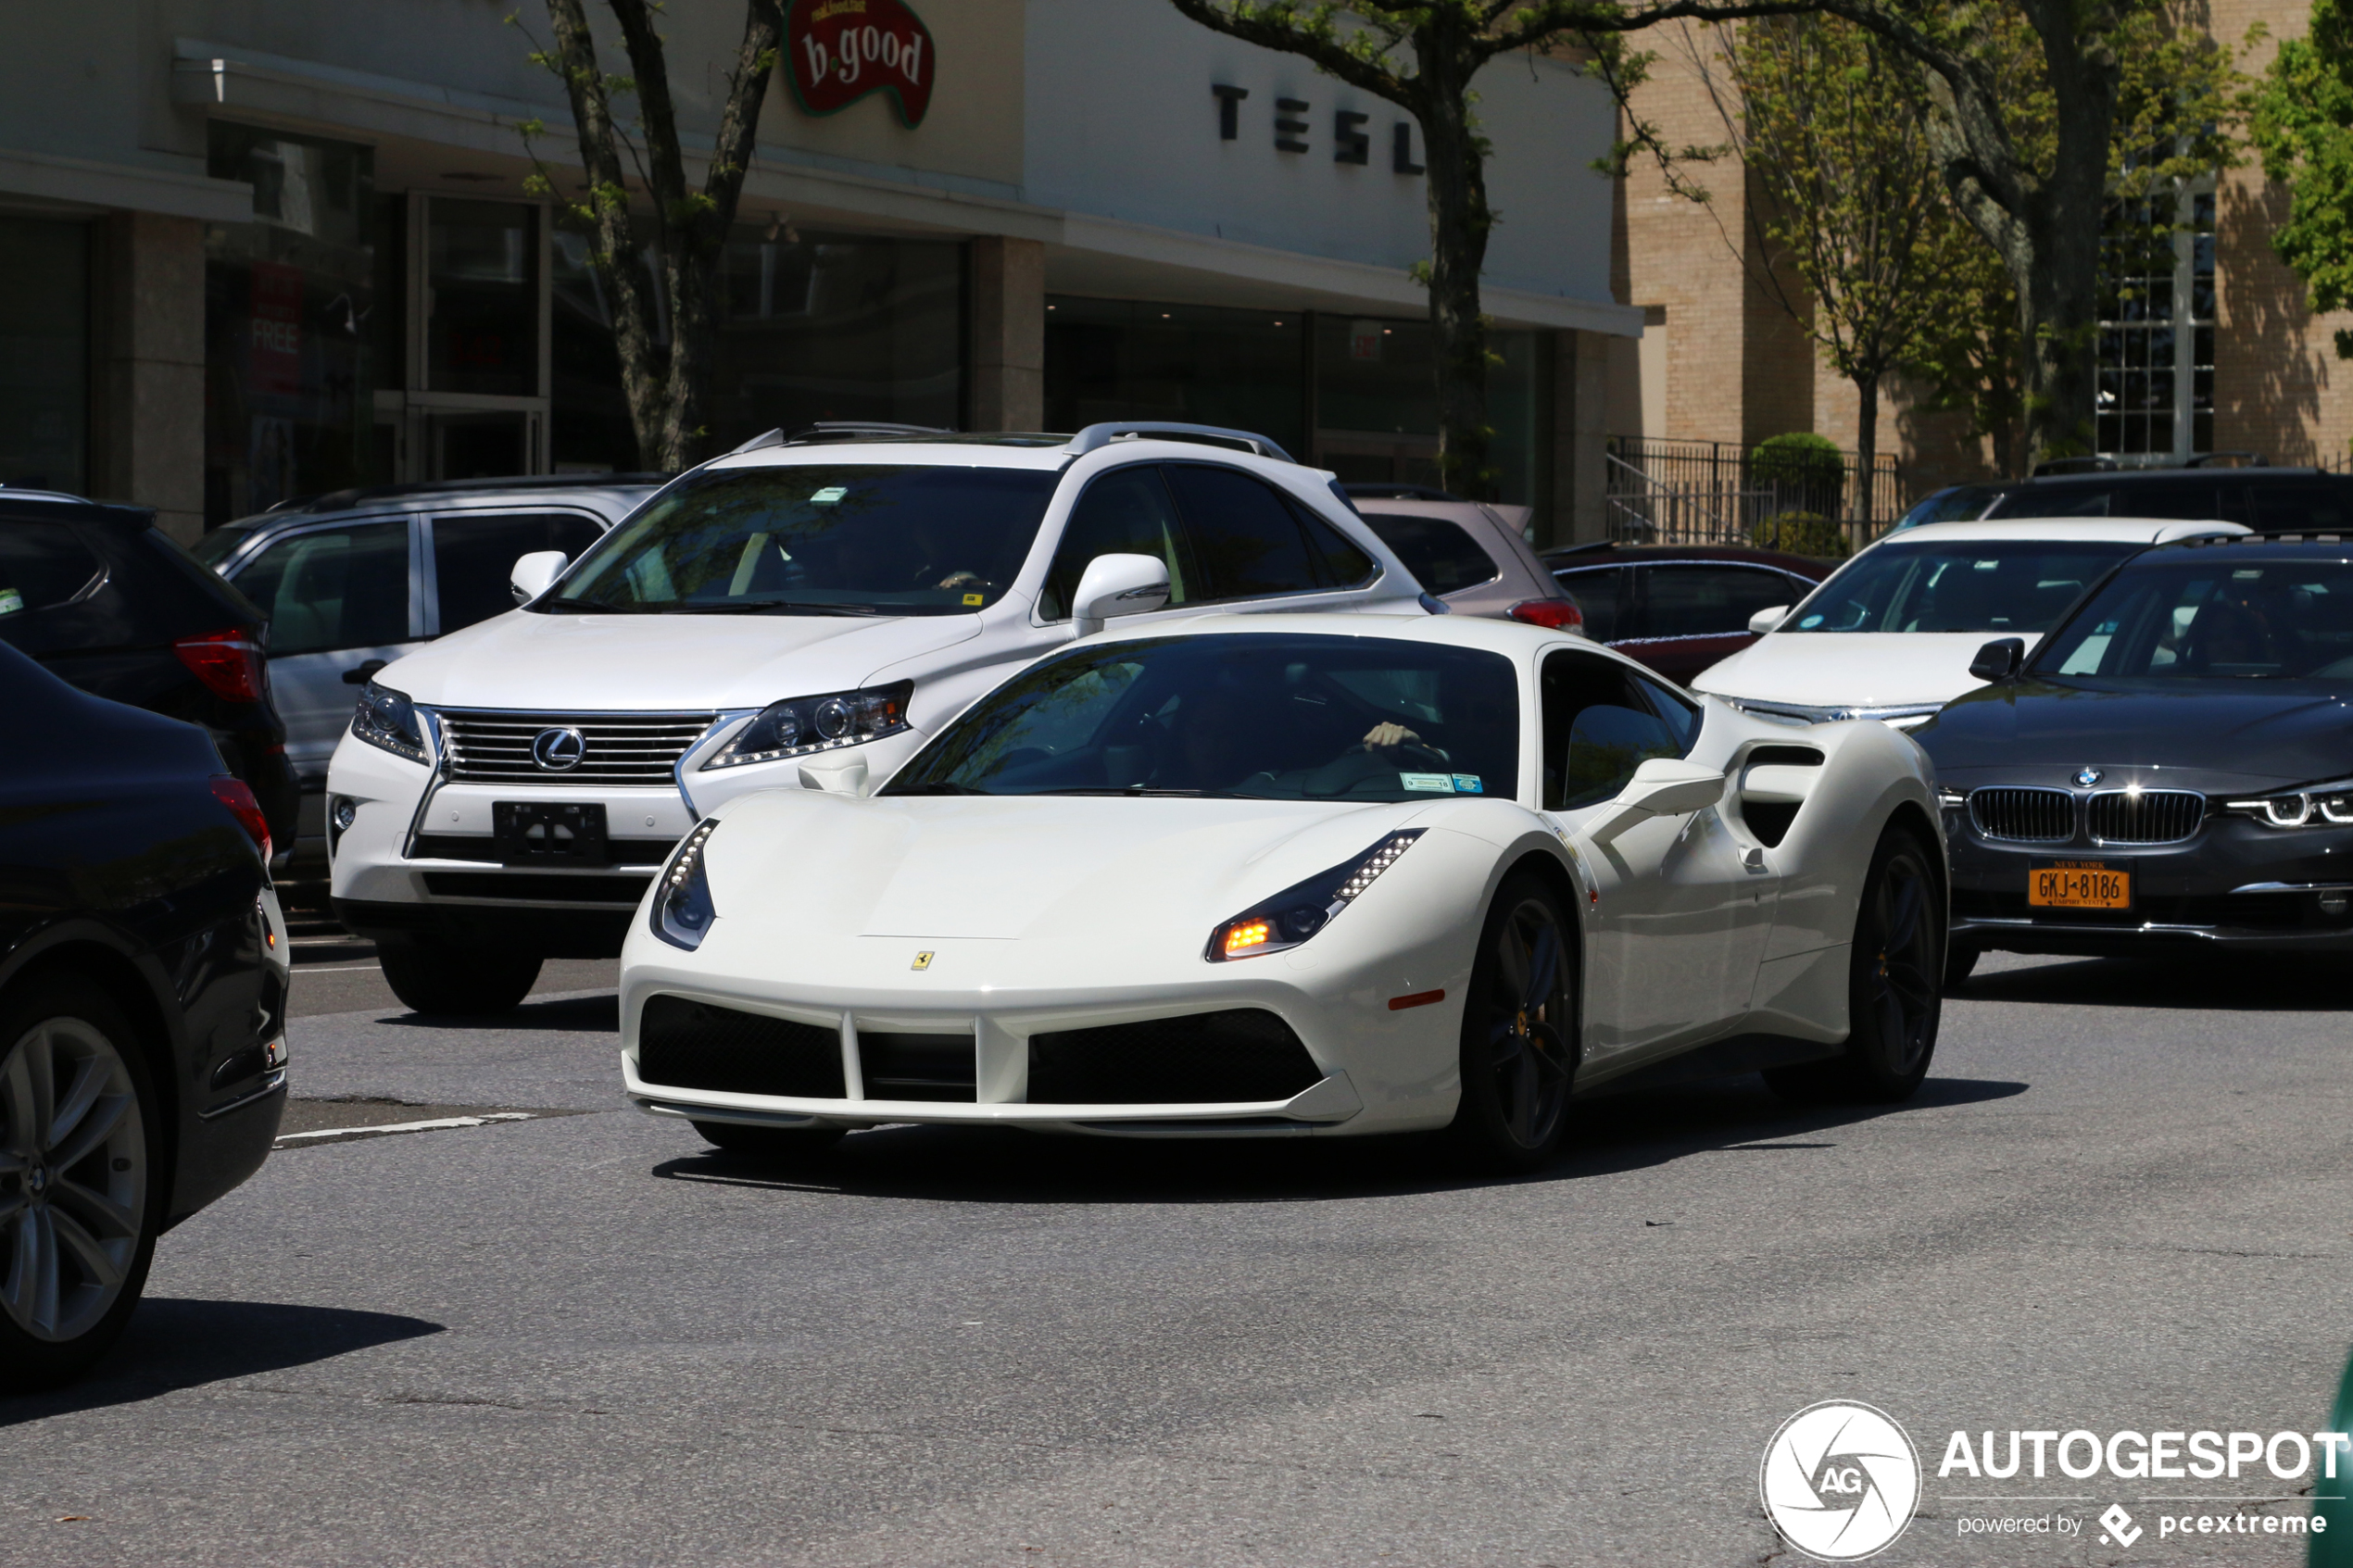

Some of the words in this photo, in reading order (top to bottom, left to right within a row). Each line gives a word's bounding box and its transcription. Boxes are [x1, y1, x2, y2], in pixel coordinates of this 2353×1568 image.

[801, 25, 923, 87] b.good
[1212, 82, 1426, 176] TESL
[252, 317, 298, 356] FREE
[2054, 860, 2078, 869] NEW
[2080, 861, 2106, 870] YORK
